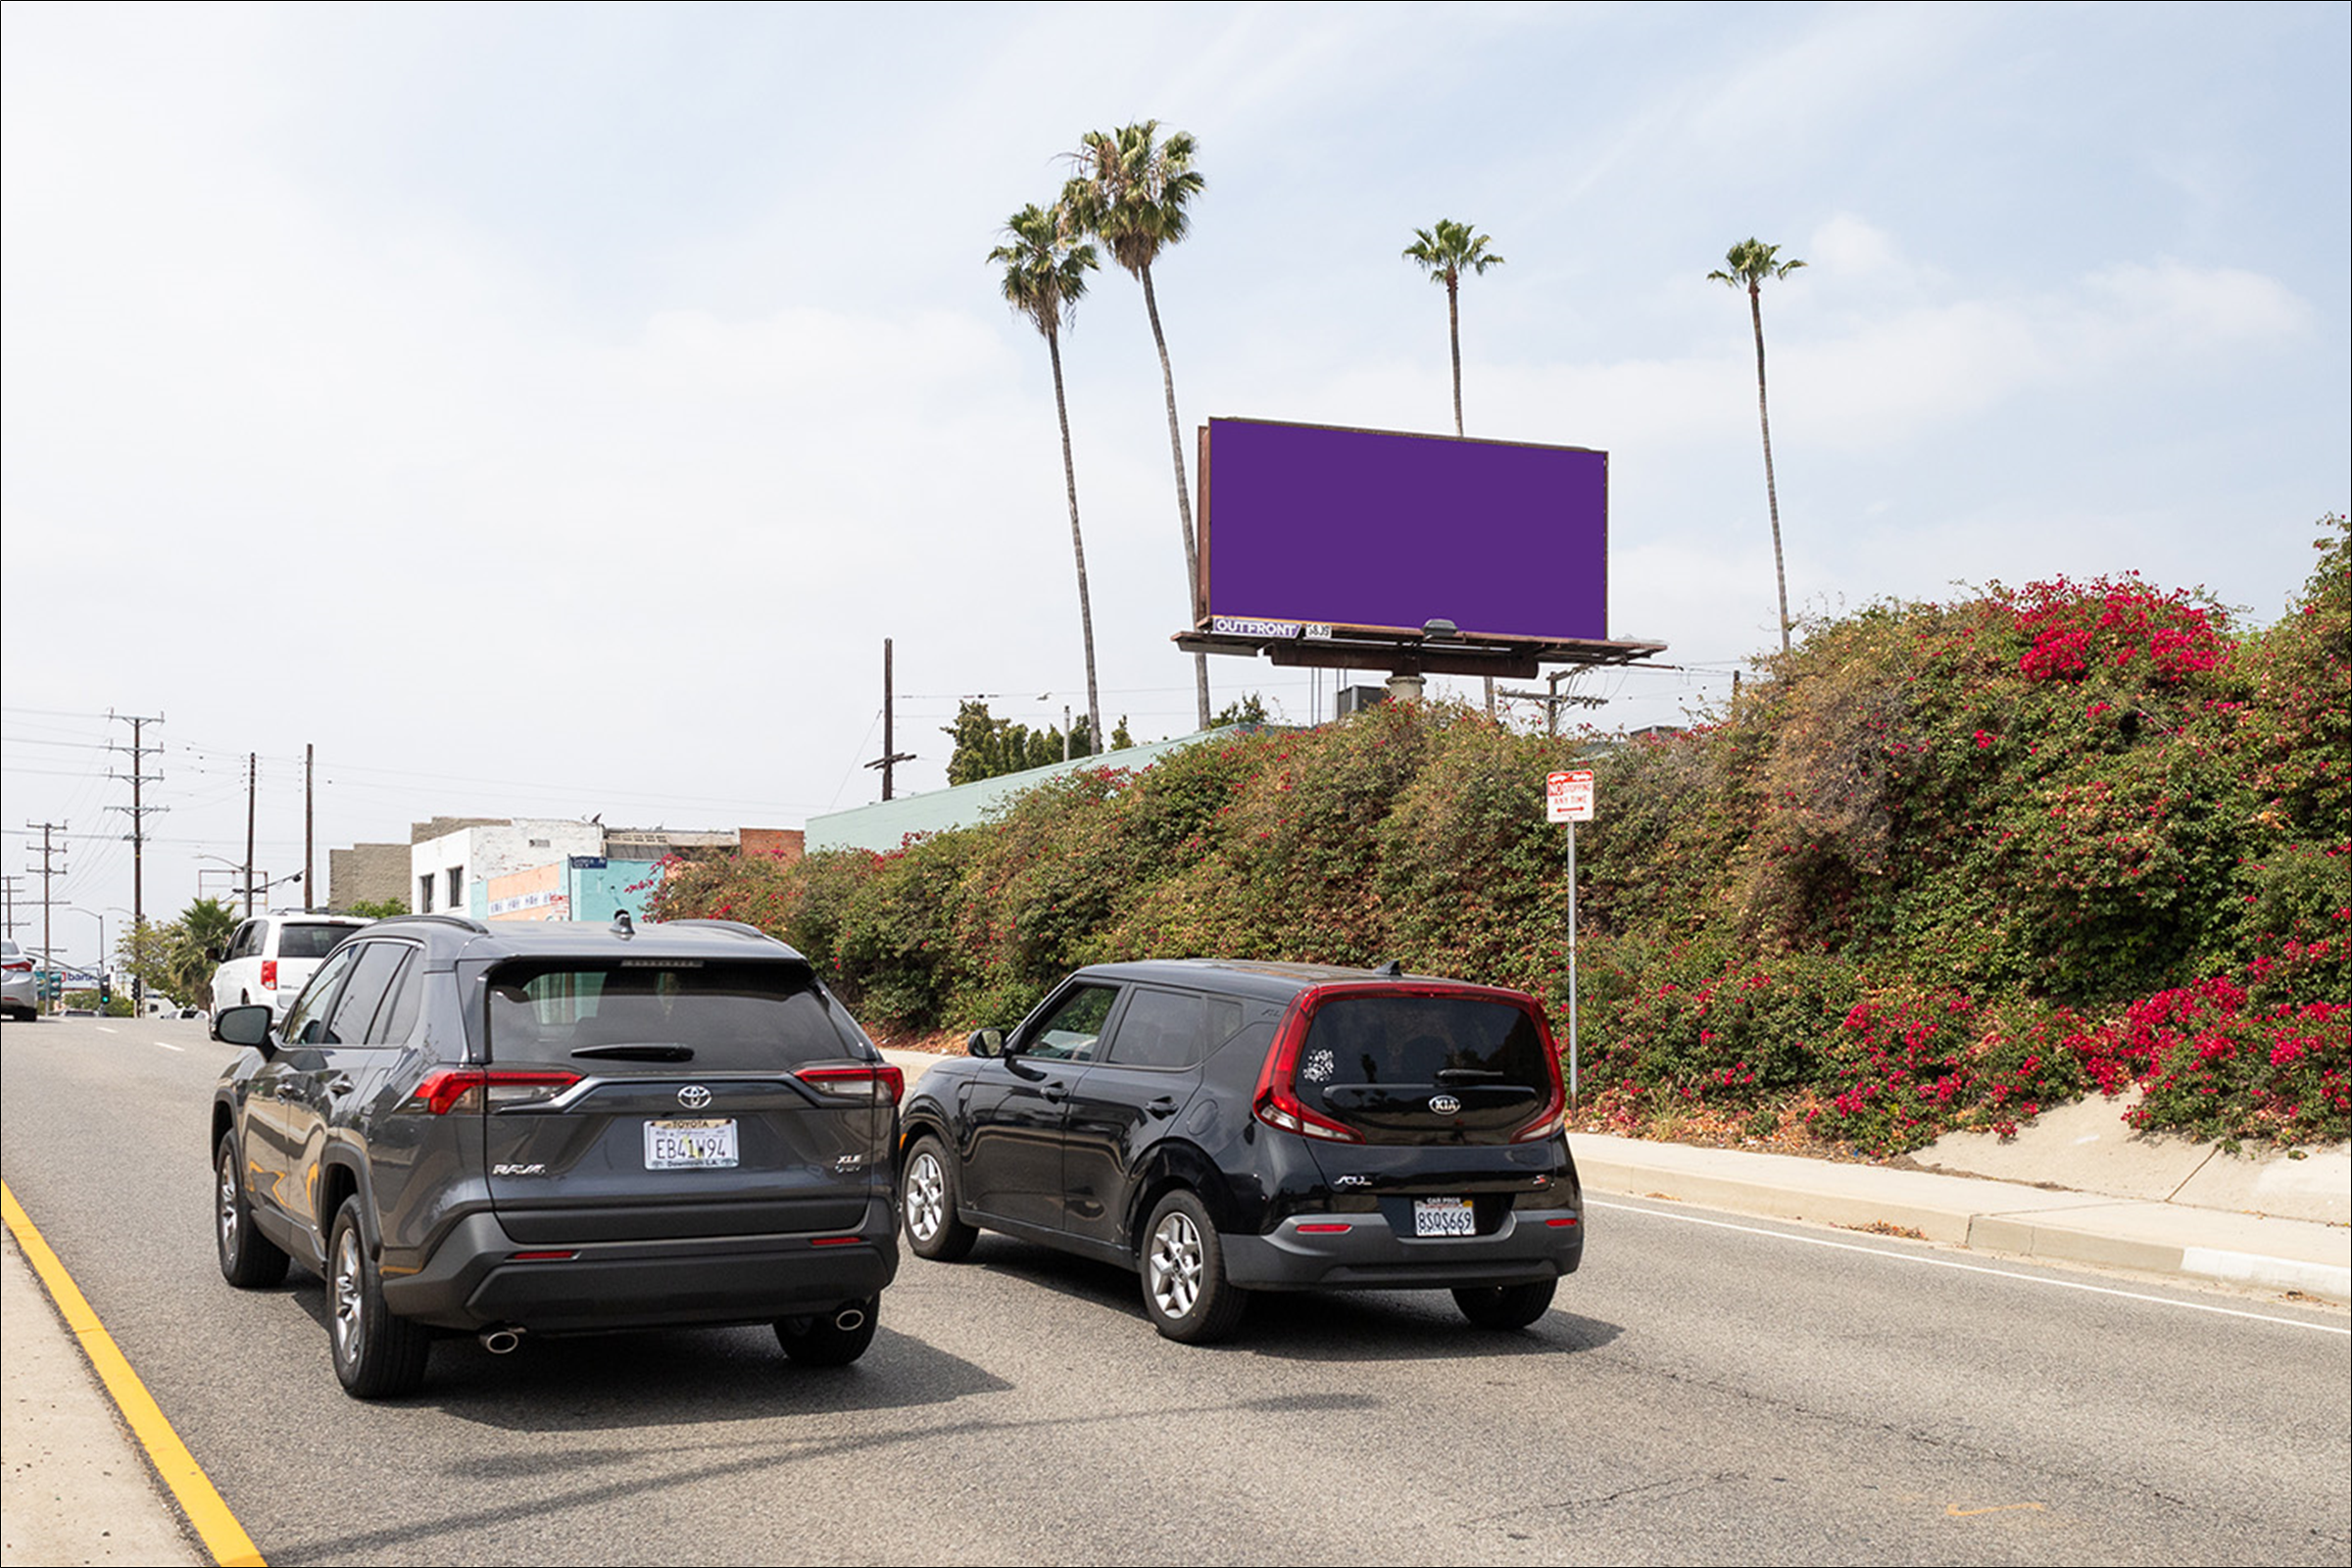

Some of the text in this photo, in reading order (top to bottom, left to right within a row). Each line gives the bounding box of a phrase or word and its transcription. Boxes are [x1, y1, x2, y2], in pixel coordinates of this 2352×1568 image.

[1216, 619, 1296, 636] OUTFRONT
[1548, 783, 1563, 796] NO
[1570, 795, 1587, 804] TIME
[1435, 1099, 1457, 1110] KIA
